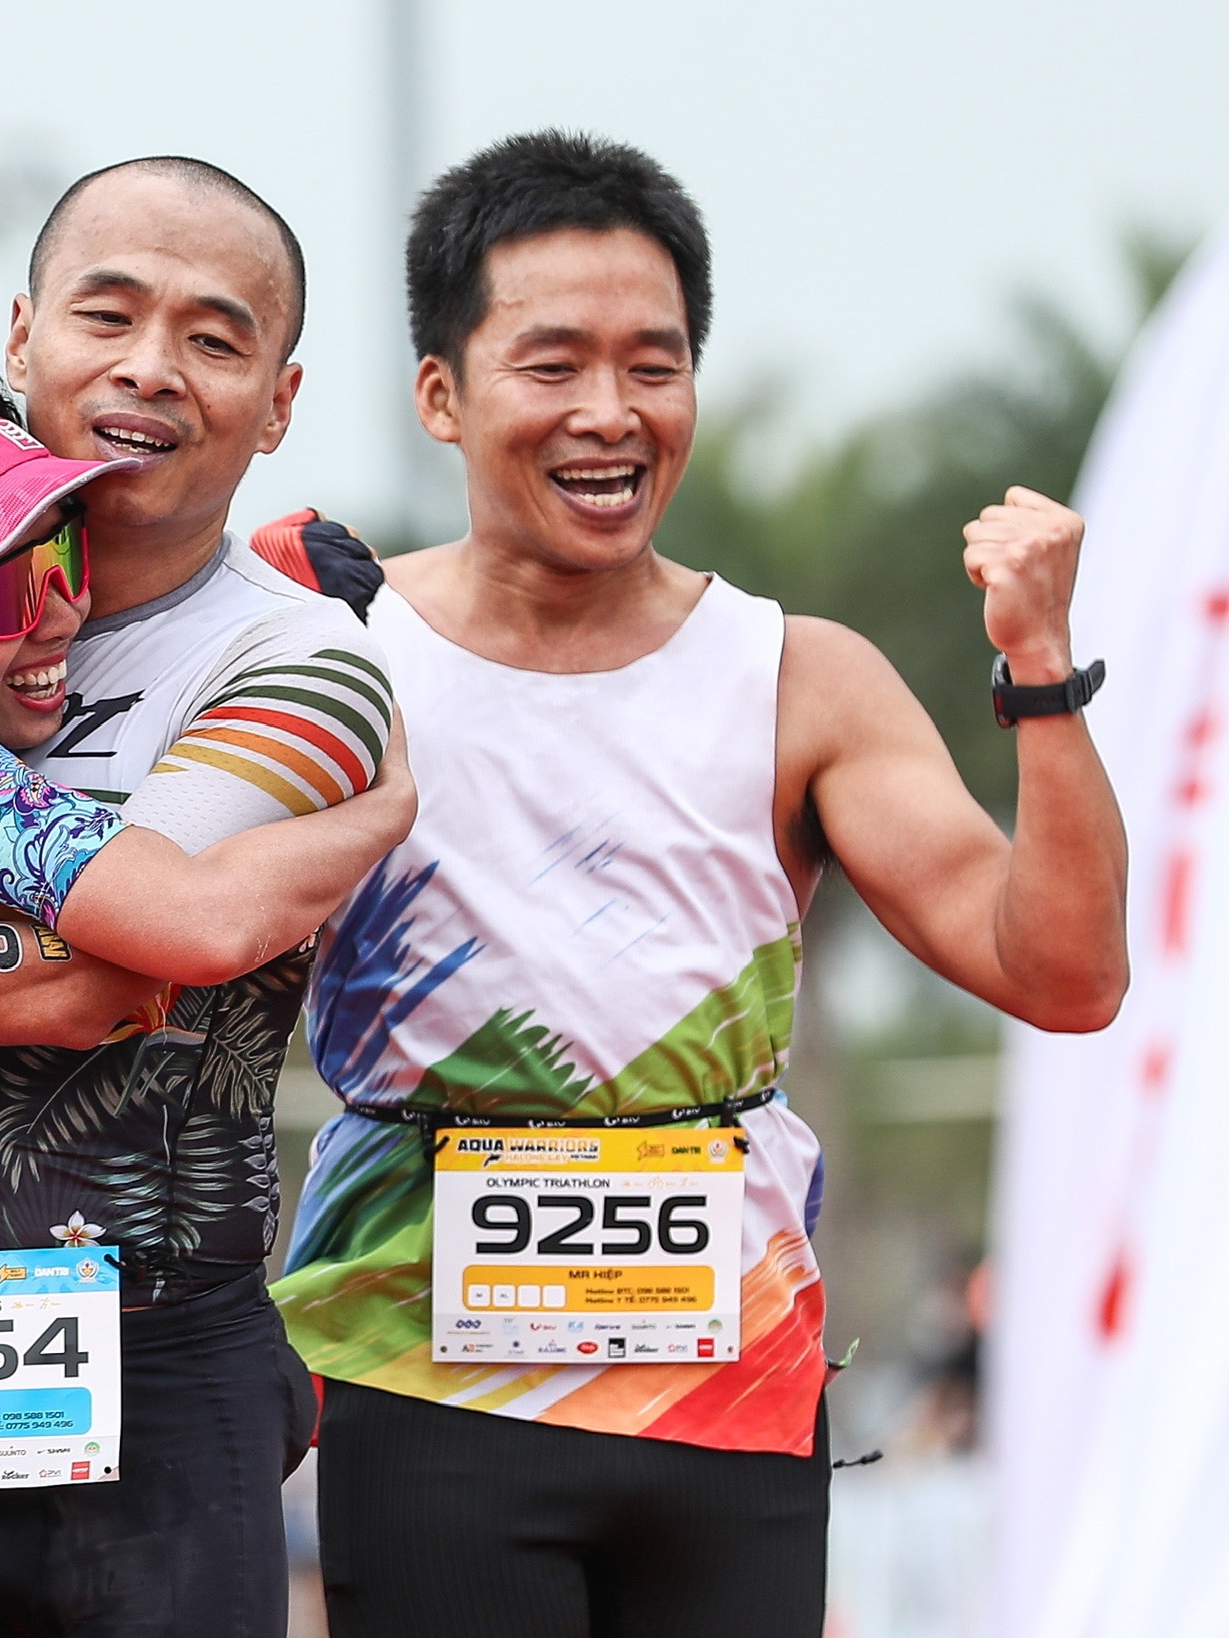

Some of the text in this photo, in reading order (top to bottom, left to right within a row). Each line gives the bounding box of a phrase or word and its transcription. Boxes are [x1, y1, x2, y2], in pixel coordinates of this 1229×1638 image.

[457, 1139, 599, 1152] AQUA WARRIORS
[486, 1178, 610, 1188] OLYMPIC TRIATHLON
[472, 1195, 709, 1255] 9256
[568, 1270, 590, 1279] MR
[2, 1412, 22, 1421] 098
[23, 1412, 43, 1420] 588
[45, 1411, 65, 1419] 1501
[6, 1422, 30, 1430] 0775
[32, 1421, 52, 1429] 949
[54, 1420, 74, 1428] 496
